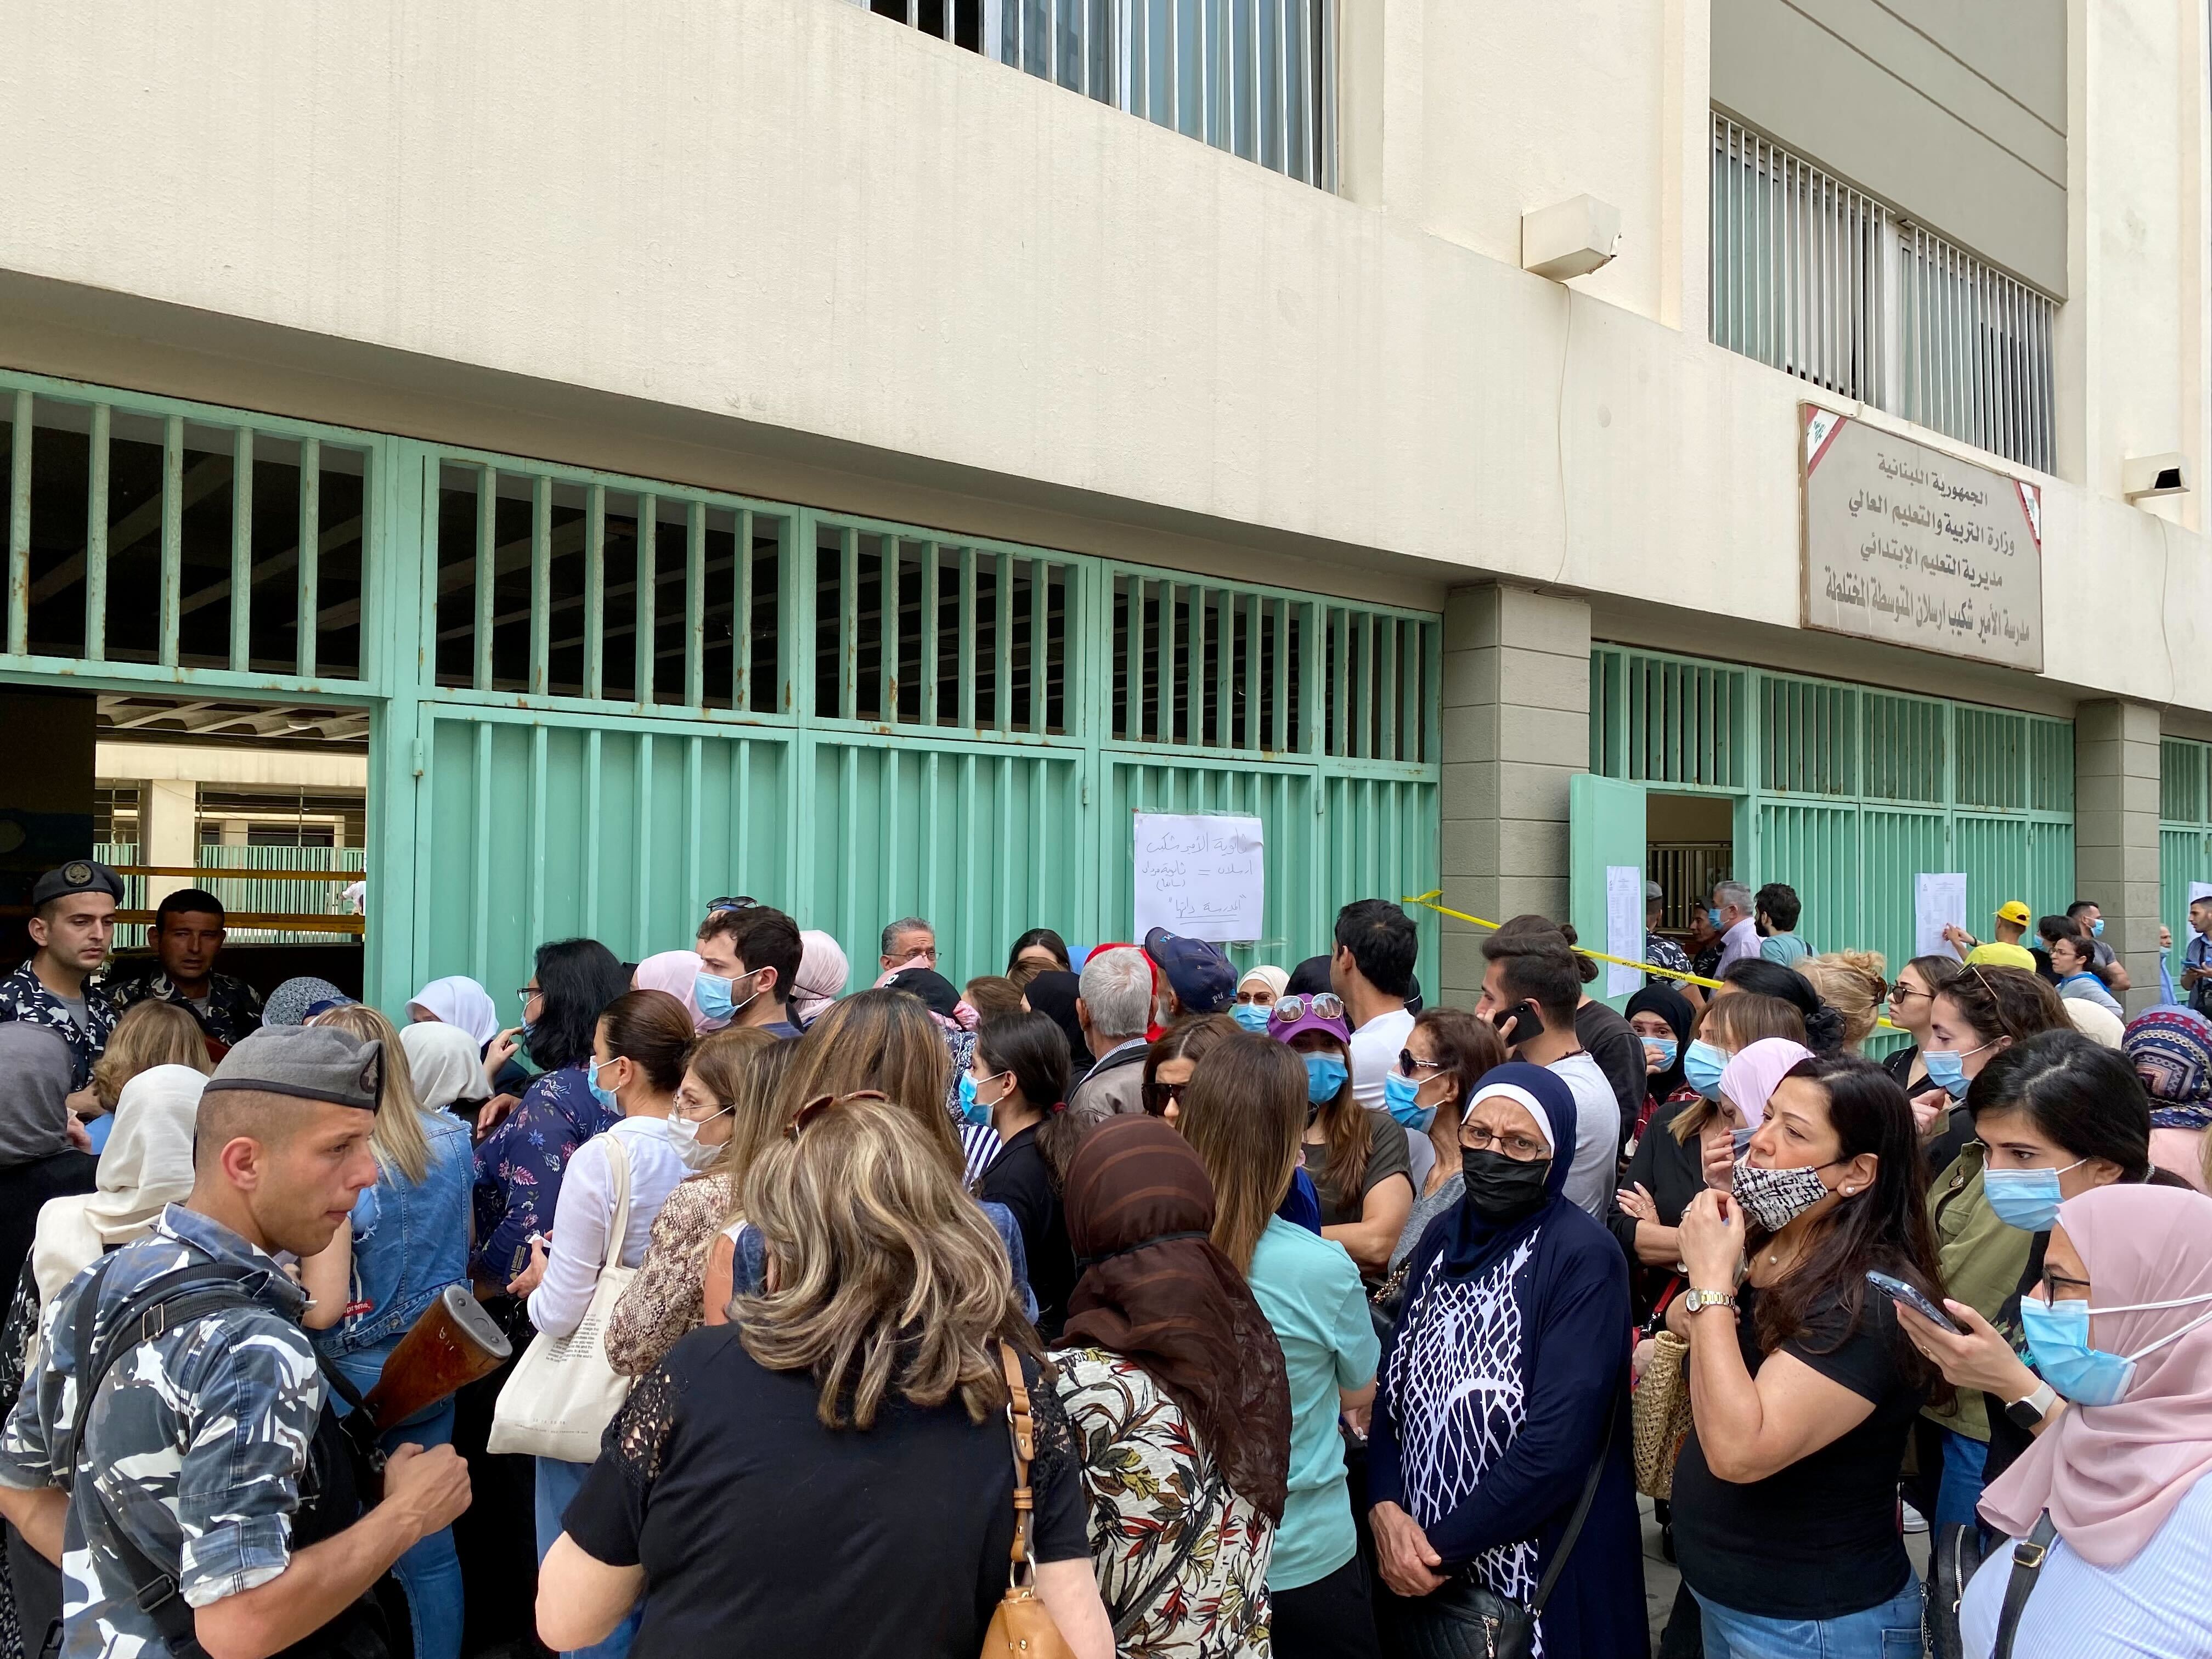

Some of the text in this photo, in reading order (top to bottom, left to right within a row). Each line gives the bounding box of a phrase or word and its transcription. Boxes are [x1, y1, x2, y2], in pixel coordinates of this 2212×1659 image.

[1877, 452, 1988, 507] الجمهورية اللبنانية
[1849, 488, 2015, 556] وزارة التربية والتعليم العالي
[1921, 553, 1960, 576] التعليم
[1962, 558, 2002, 591] مديرية
[1825, 565, 1869, 609] المختلطة
[1872, 576, 1913, 623] المتوسطة
[1949, 597, 1973, 636] شكيب
[1977, 603, 2001, 645] الأمير
[2004, 608, 2029, 647] مدرسة
